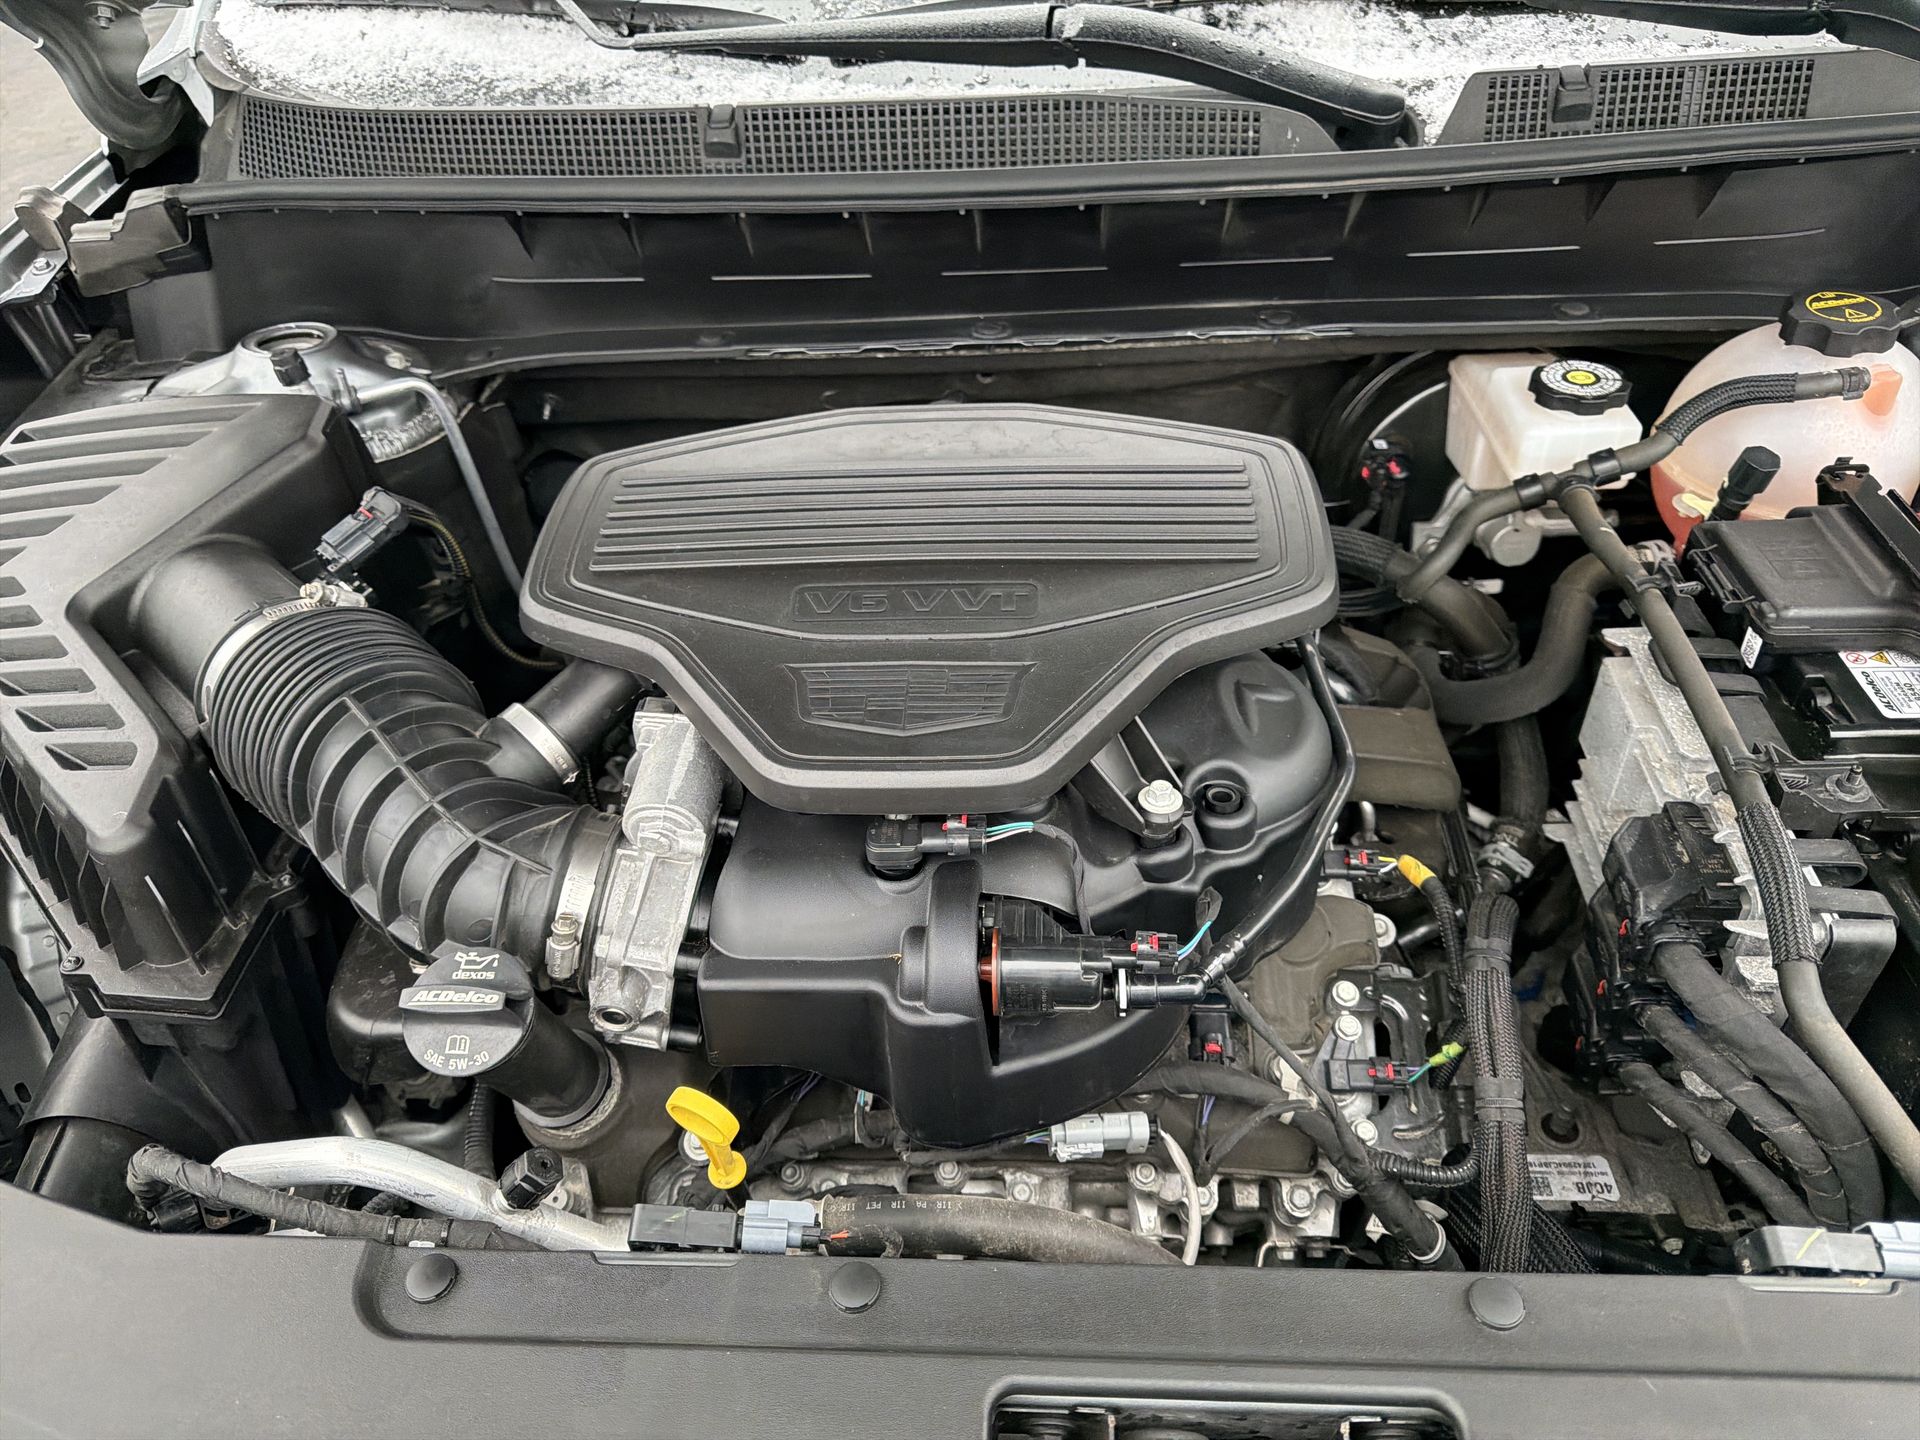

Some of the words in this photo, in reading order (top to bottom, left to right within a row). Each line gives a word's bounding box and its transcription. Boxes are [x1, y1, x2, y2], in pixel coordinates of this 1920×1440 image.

[804, 590, 889, 614] V6
[903, 587, 1030, 612] VVT
[1861, 671, 1897, 712] ACDelco
[451, 969, 496, 980] dexos
[411, 990, 500, 1004] ACDelco
[423, 1049, 446, 1068] SAE
[448, 1051, 490, 1070] 5W-30
[865, 1201, 882, 1210] PET
[916, 1200, 927, 1209] PA
